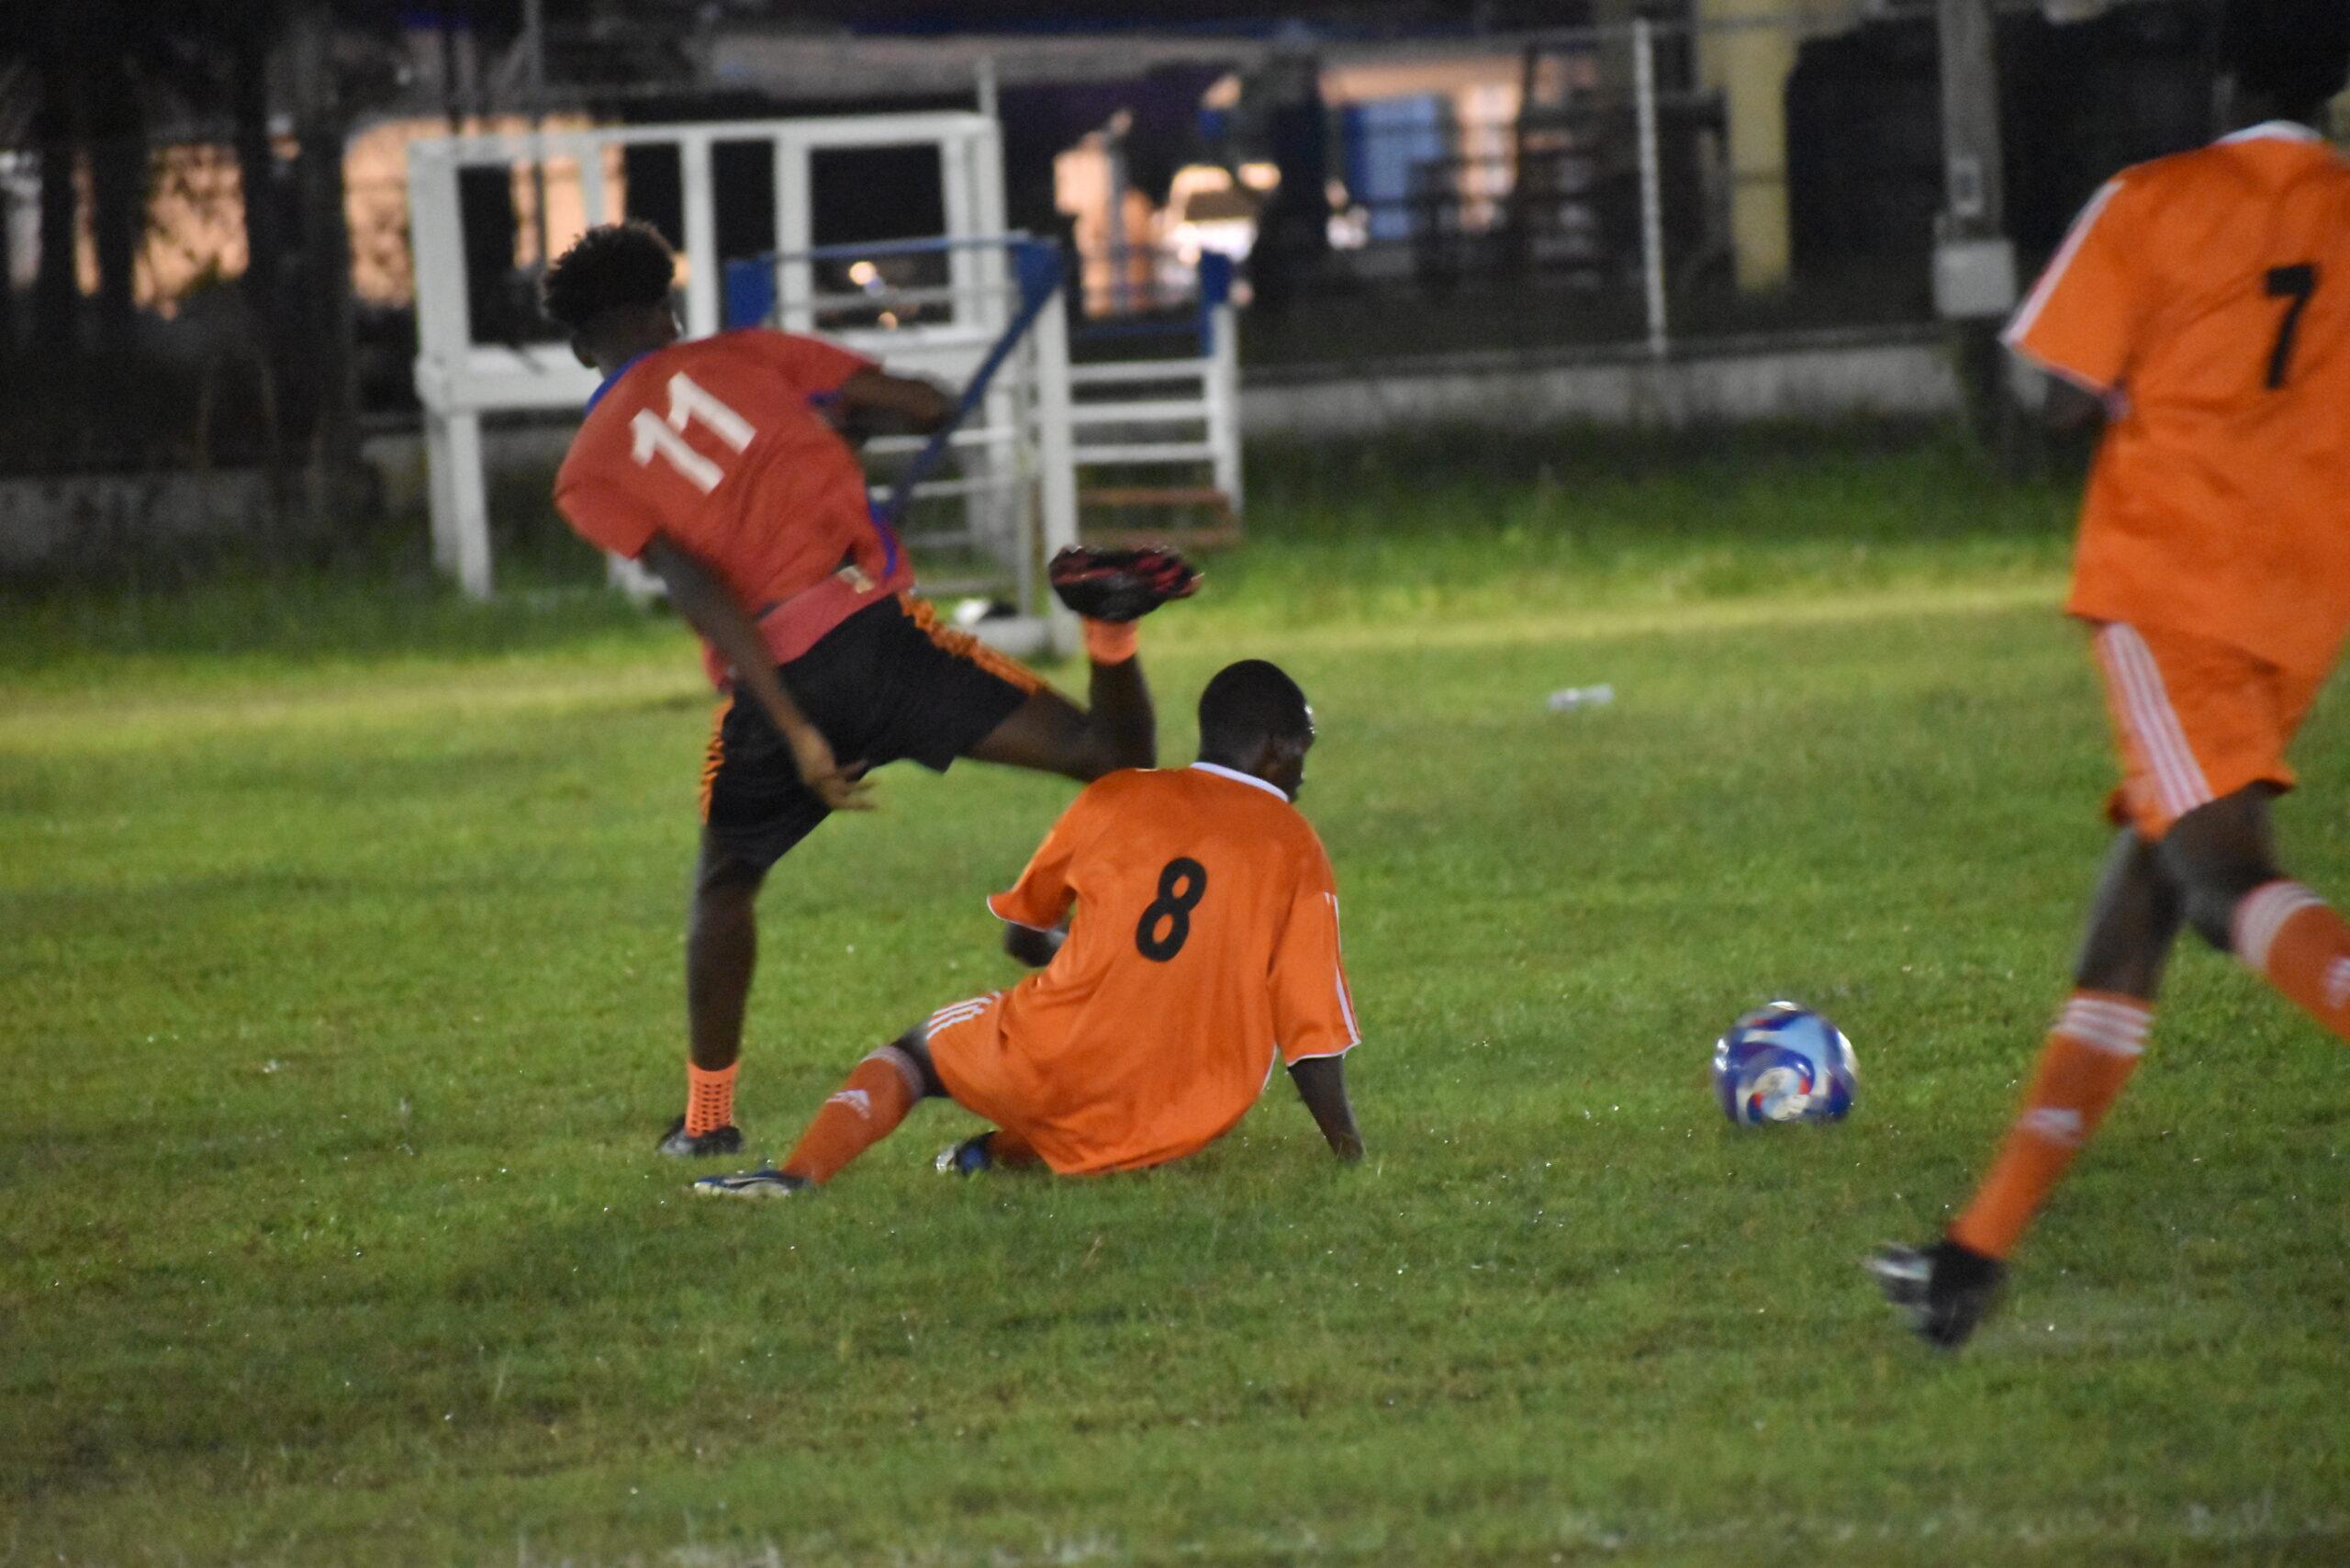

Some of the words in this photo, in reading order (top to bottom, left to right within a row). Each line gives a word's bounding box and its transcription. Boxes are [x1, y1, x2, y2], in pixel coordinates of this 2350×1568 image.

[2264, 263, 2321, 389] 7
[630, 371, 755, 494] 11
[1136, 857, 1207, 962] 8
